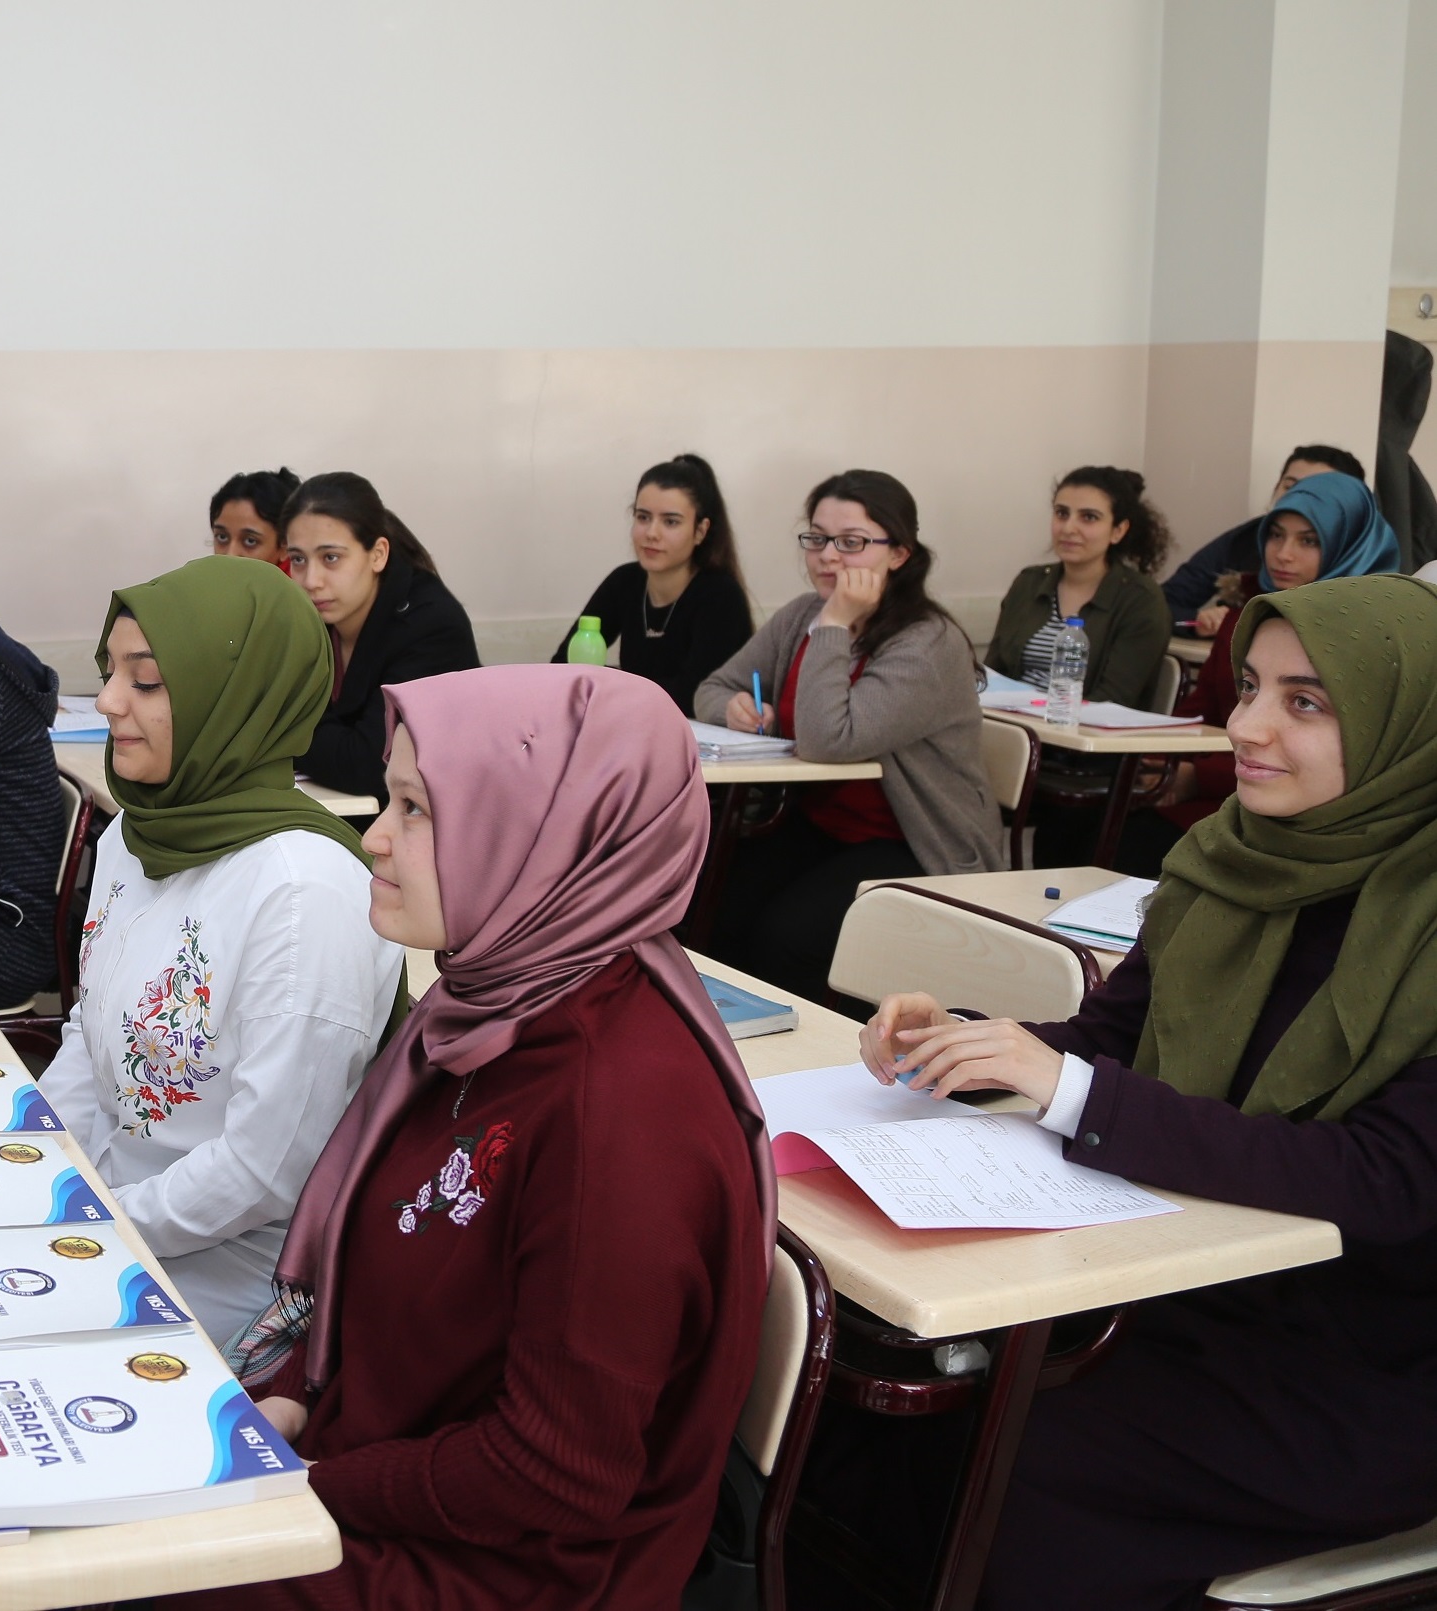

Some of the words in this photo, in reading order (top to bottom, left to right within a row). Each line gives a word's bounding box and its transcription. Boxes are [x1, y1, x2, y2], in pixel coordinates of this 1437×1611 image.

[39, 1115, 56, 1129] YKS
[82, 1205, 101, 1220] YKS
[145, 1295, 167, 1308] YKS
[158, 1311, 182, 1322] AYT
[239, 1426, 265, 1445] YKS
[257, 1450, 284, 1469] TYT
